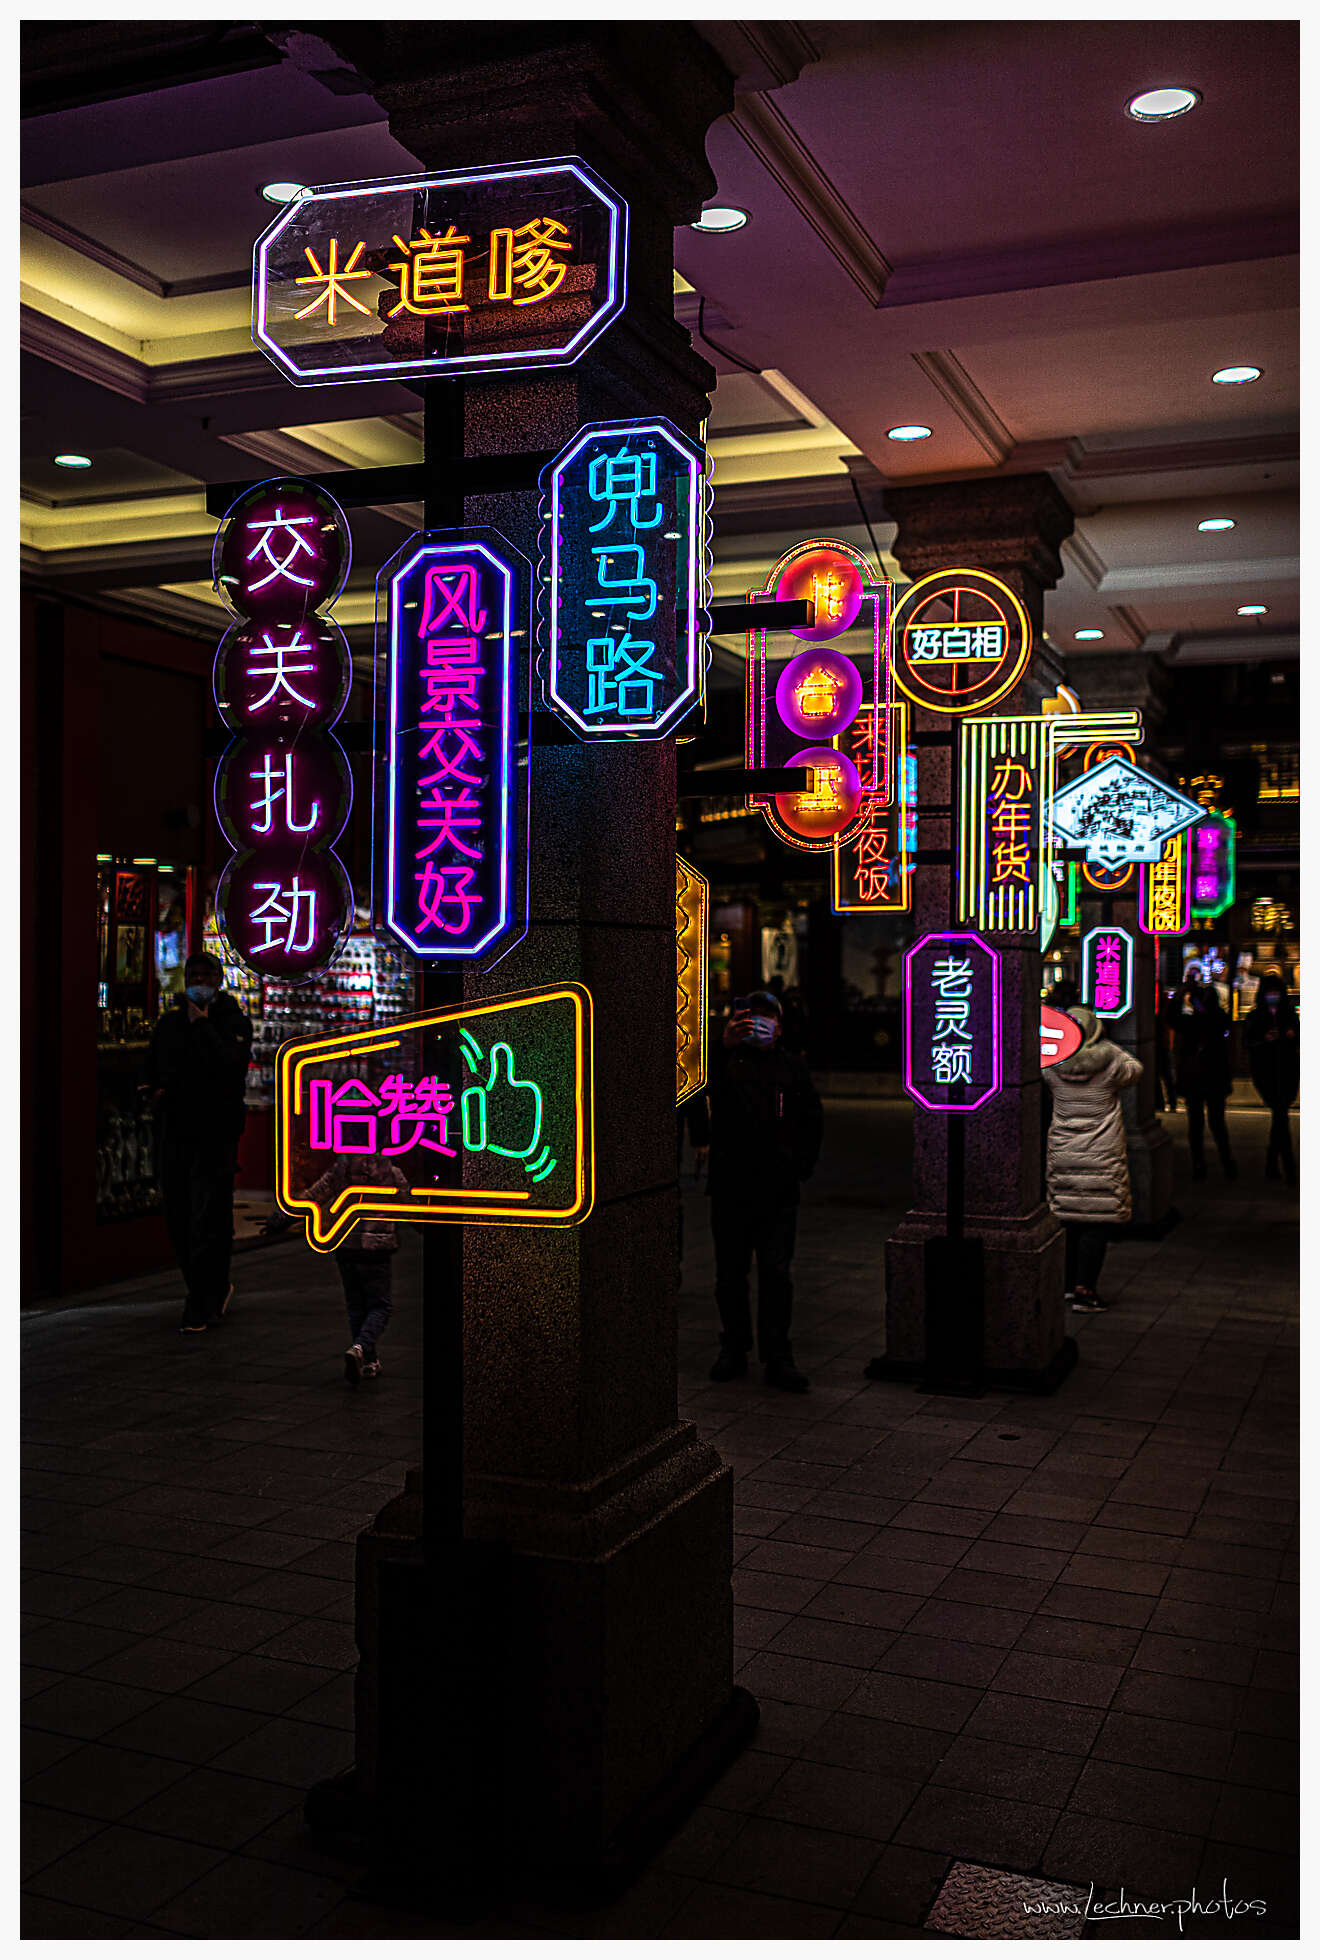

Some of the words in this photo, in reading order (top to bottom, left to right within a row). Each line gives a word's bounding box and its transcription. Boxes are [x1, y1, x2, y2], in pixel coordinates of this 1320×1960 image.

[294, 217, 572, 326] 米道嗲
[583, 447, 664, 715] 兜马路
[912, 626, 1003, 660] 好白相
[247, 509, 318, 953] 交关扎劲
[414, 565, 487, 934] 风景交关好
[990, 757, 1033, 883] 办年货
[931, 955, 974, 1084] 老灵额
[310, 1073, 457, 1157] 哈赞
